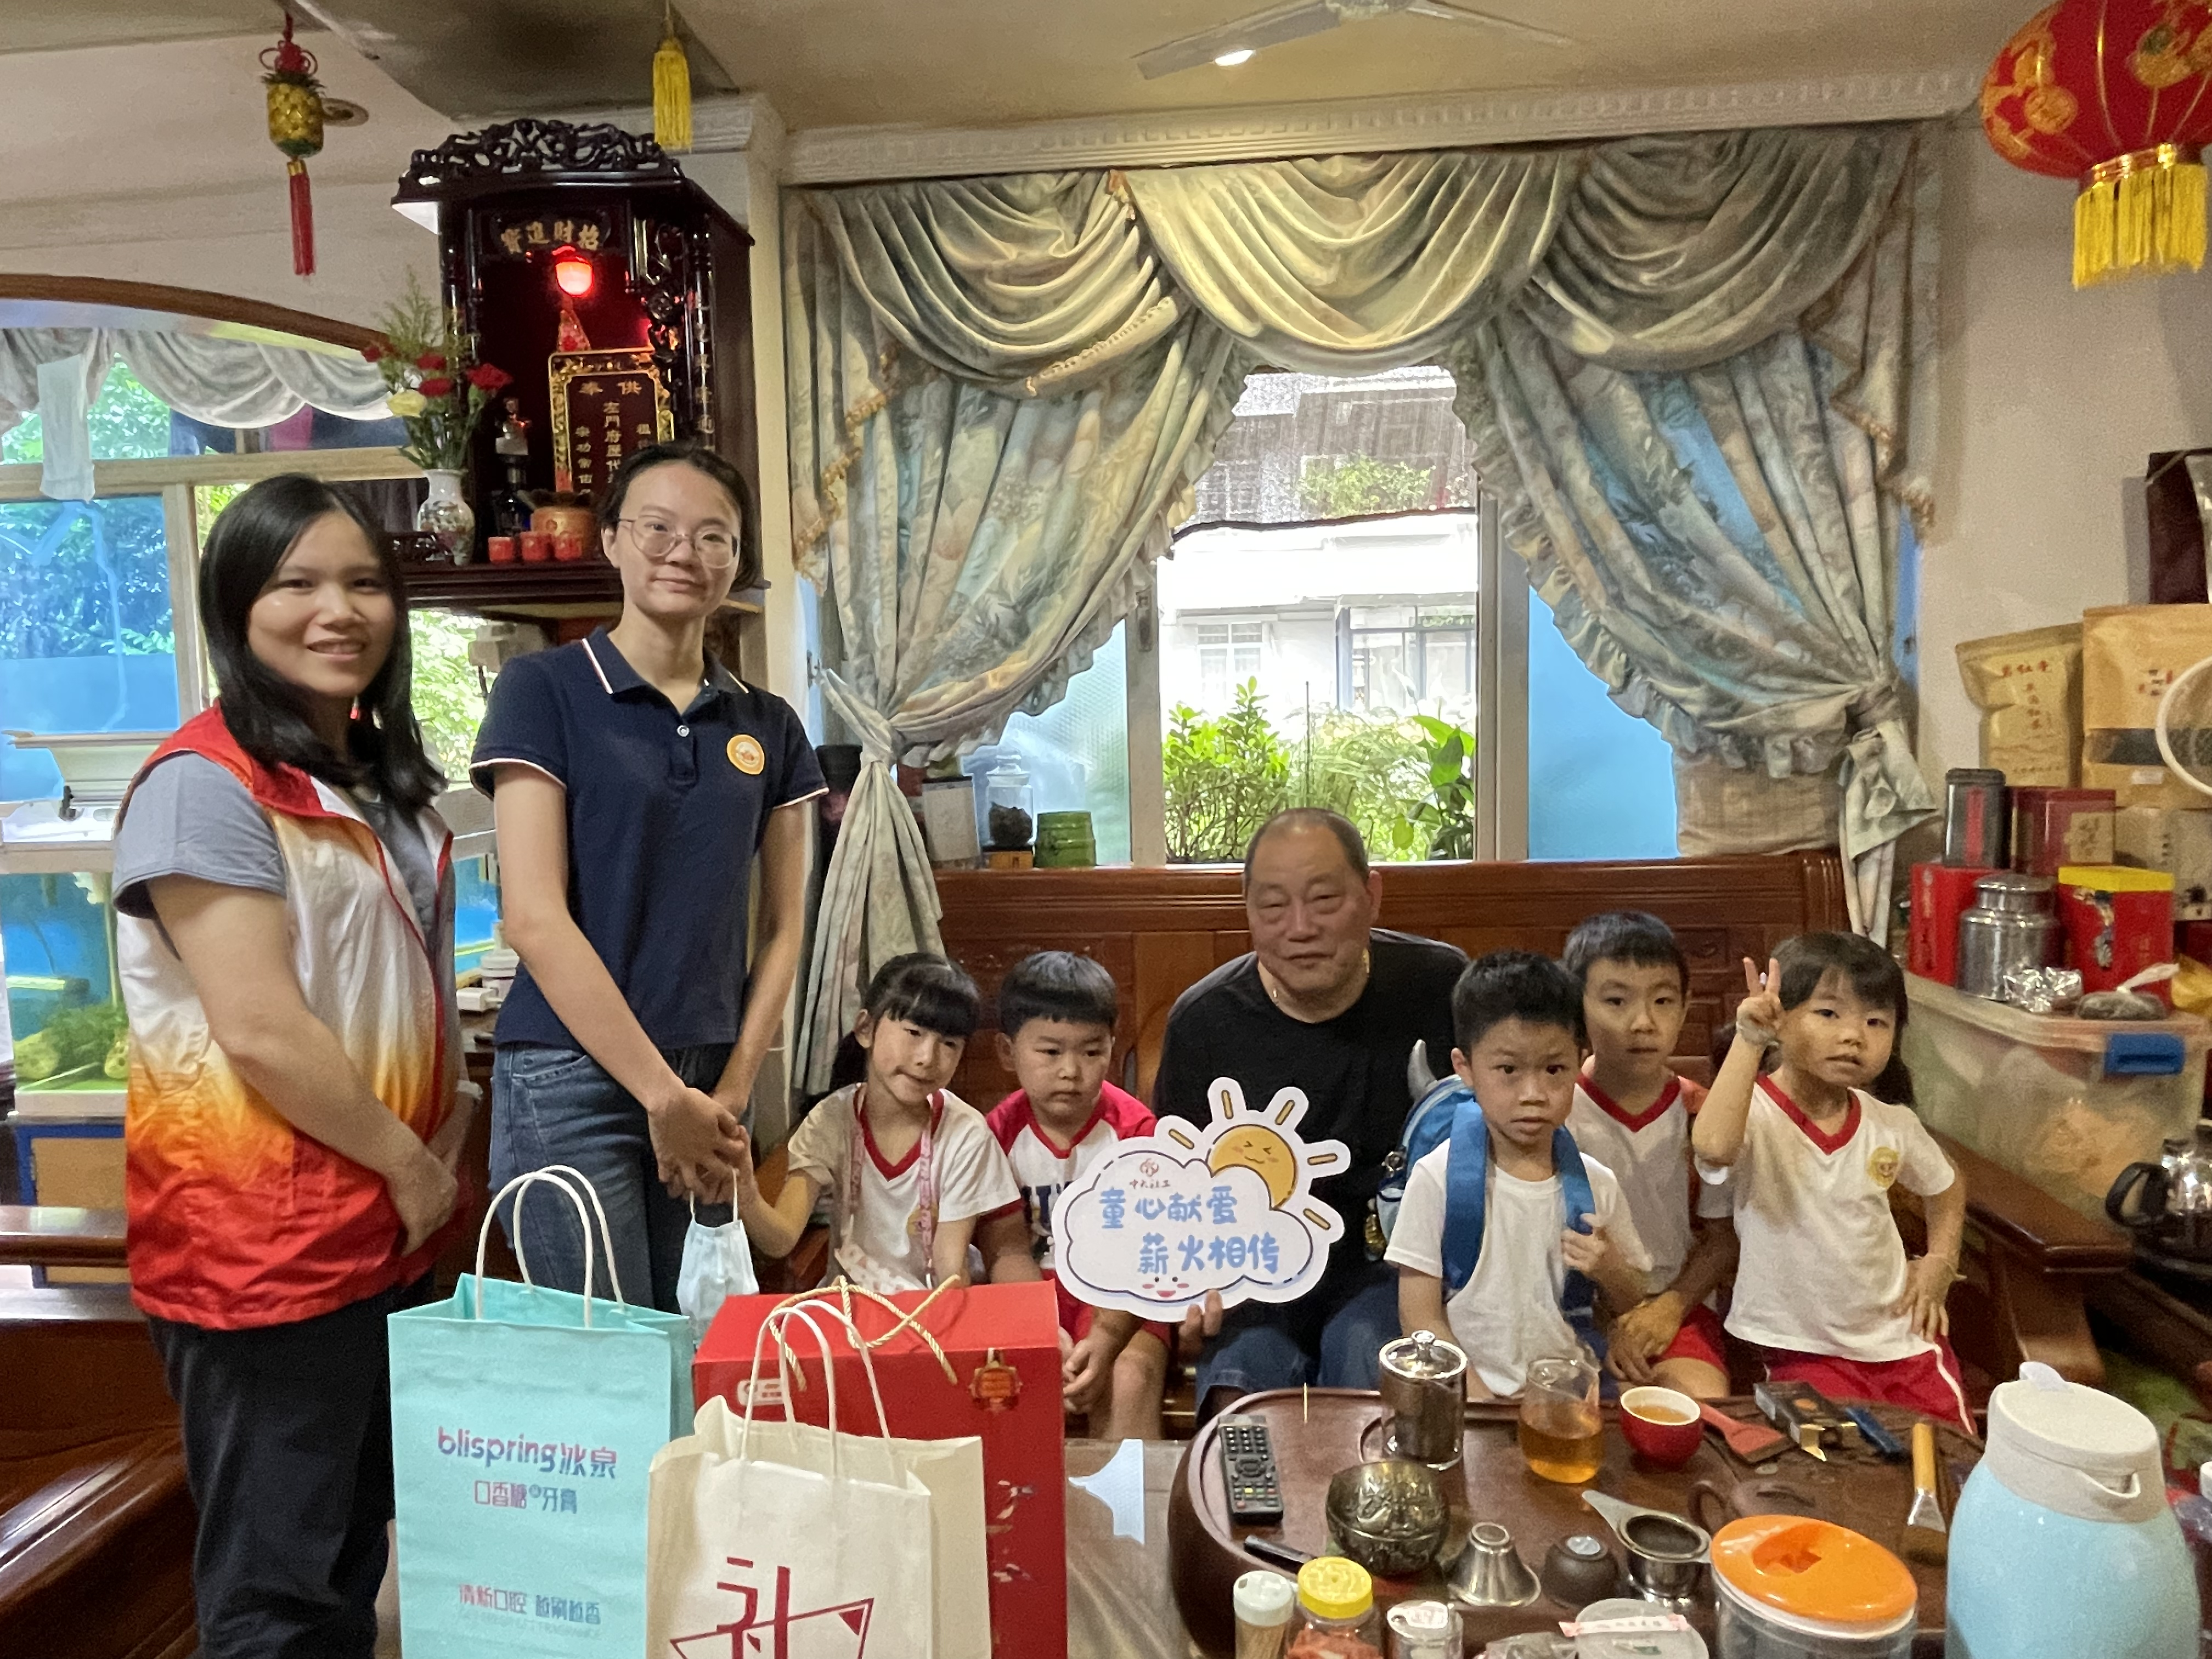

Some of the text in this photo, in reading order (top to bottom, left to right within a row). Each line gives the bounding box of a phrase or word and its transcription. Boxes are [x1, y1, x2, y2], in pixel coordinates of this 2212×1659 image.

[1098, 1186, 1238, 1229] 童心献爱
[1137, 1231, 1280, 1276] 薪火相传
